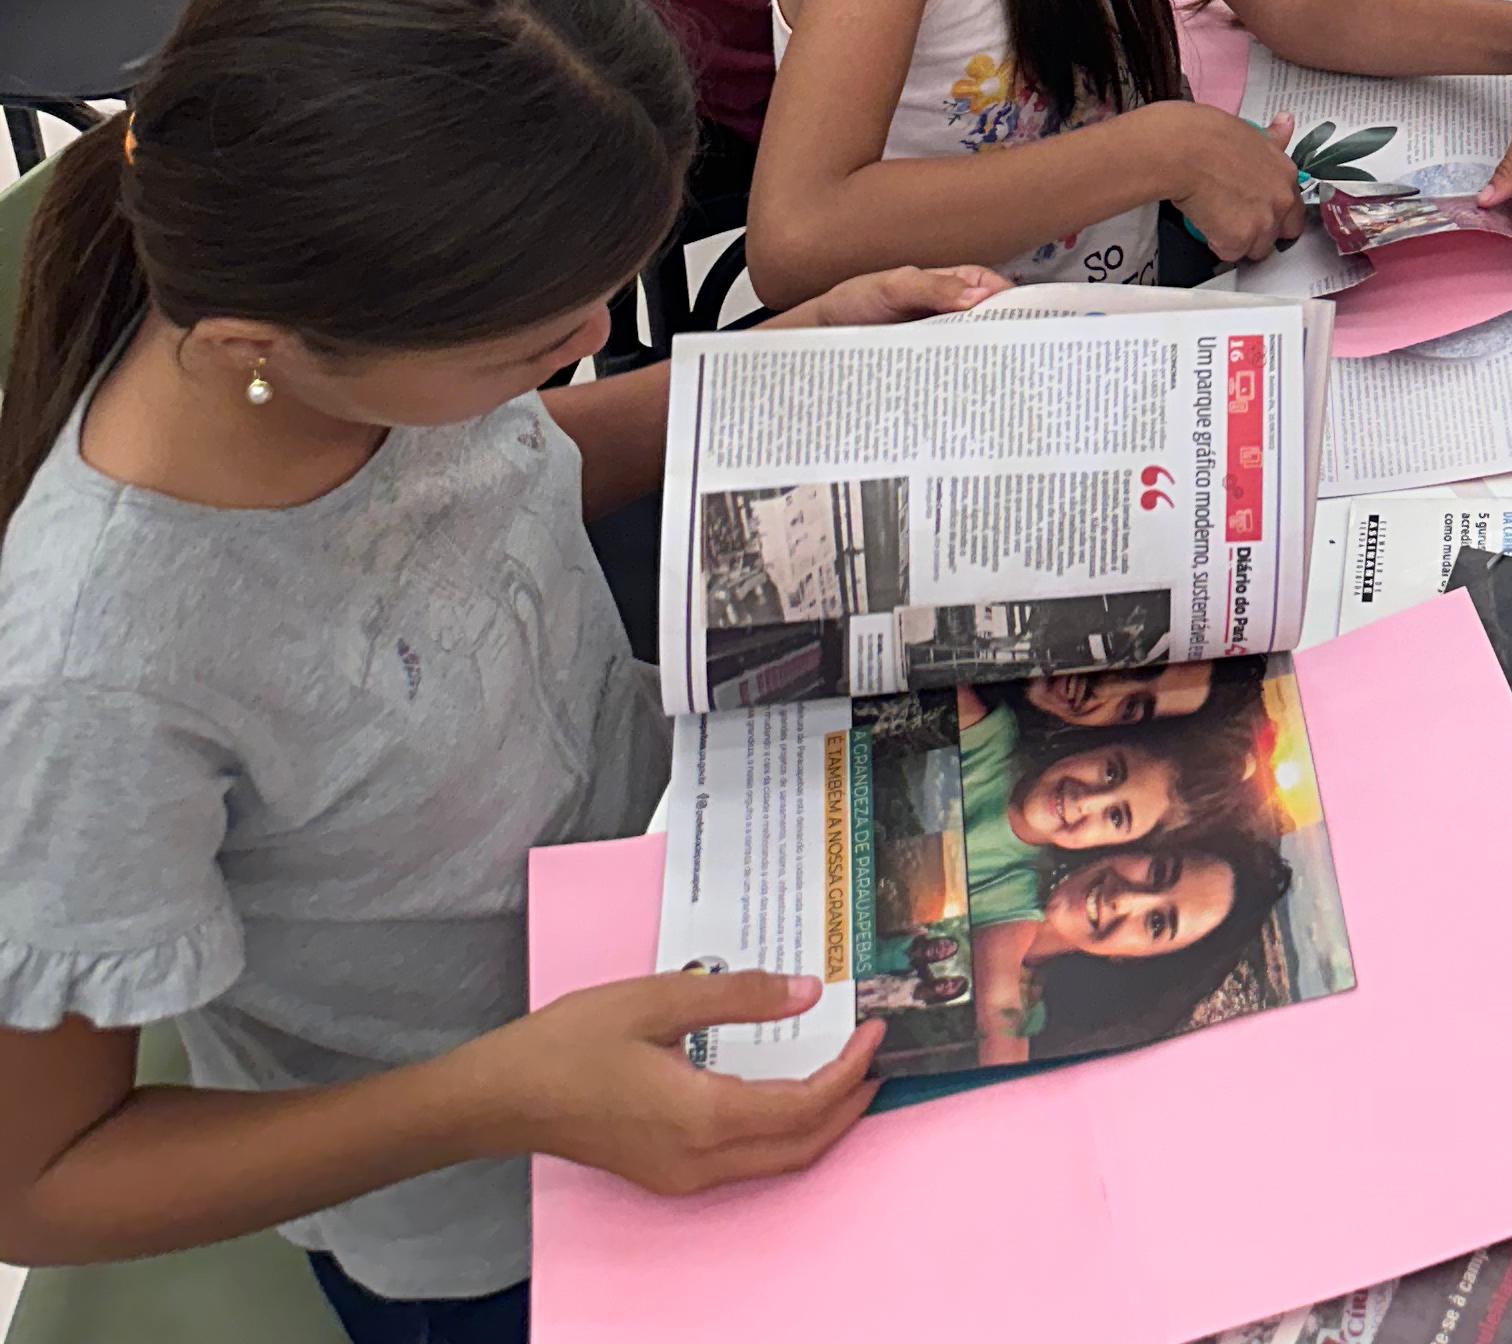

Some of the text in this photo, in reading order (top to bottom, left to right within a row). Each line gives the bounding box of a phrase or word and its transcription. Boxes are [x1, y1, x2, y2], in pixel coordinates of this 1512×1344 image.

[1230, 339, 1245, 362] 16
[1186, 336, 1216, 645] Um parque gráfico moderno, sustentável
[1364, 521, 1377, 594] ASSINANTE
[1443, 514, 1453, 541] como
[1461, 513, 1471, 546] acredi
[1232, 547, 1251, 643] Diário do Pará
[826, 745, 843, 814] TAMBÉM
[853, 742, 867, 828] GRANDEZA
[828, 831, 842, 885] NOSSA
[854, 831, 867, 854] DE
[828, 889, 843, 979] GRANDEZA.
[855, 856, 871, 973] PARAUAPEBAS
